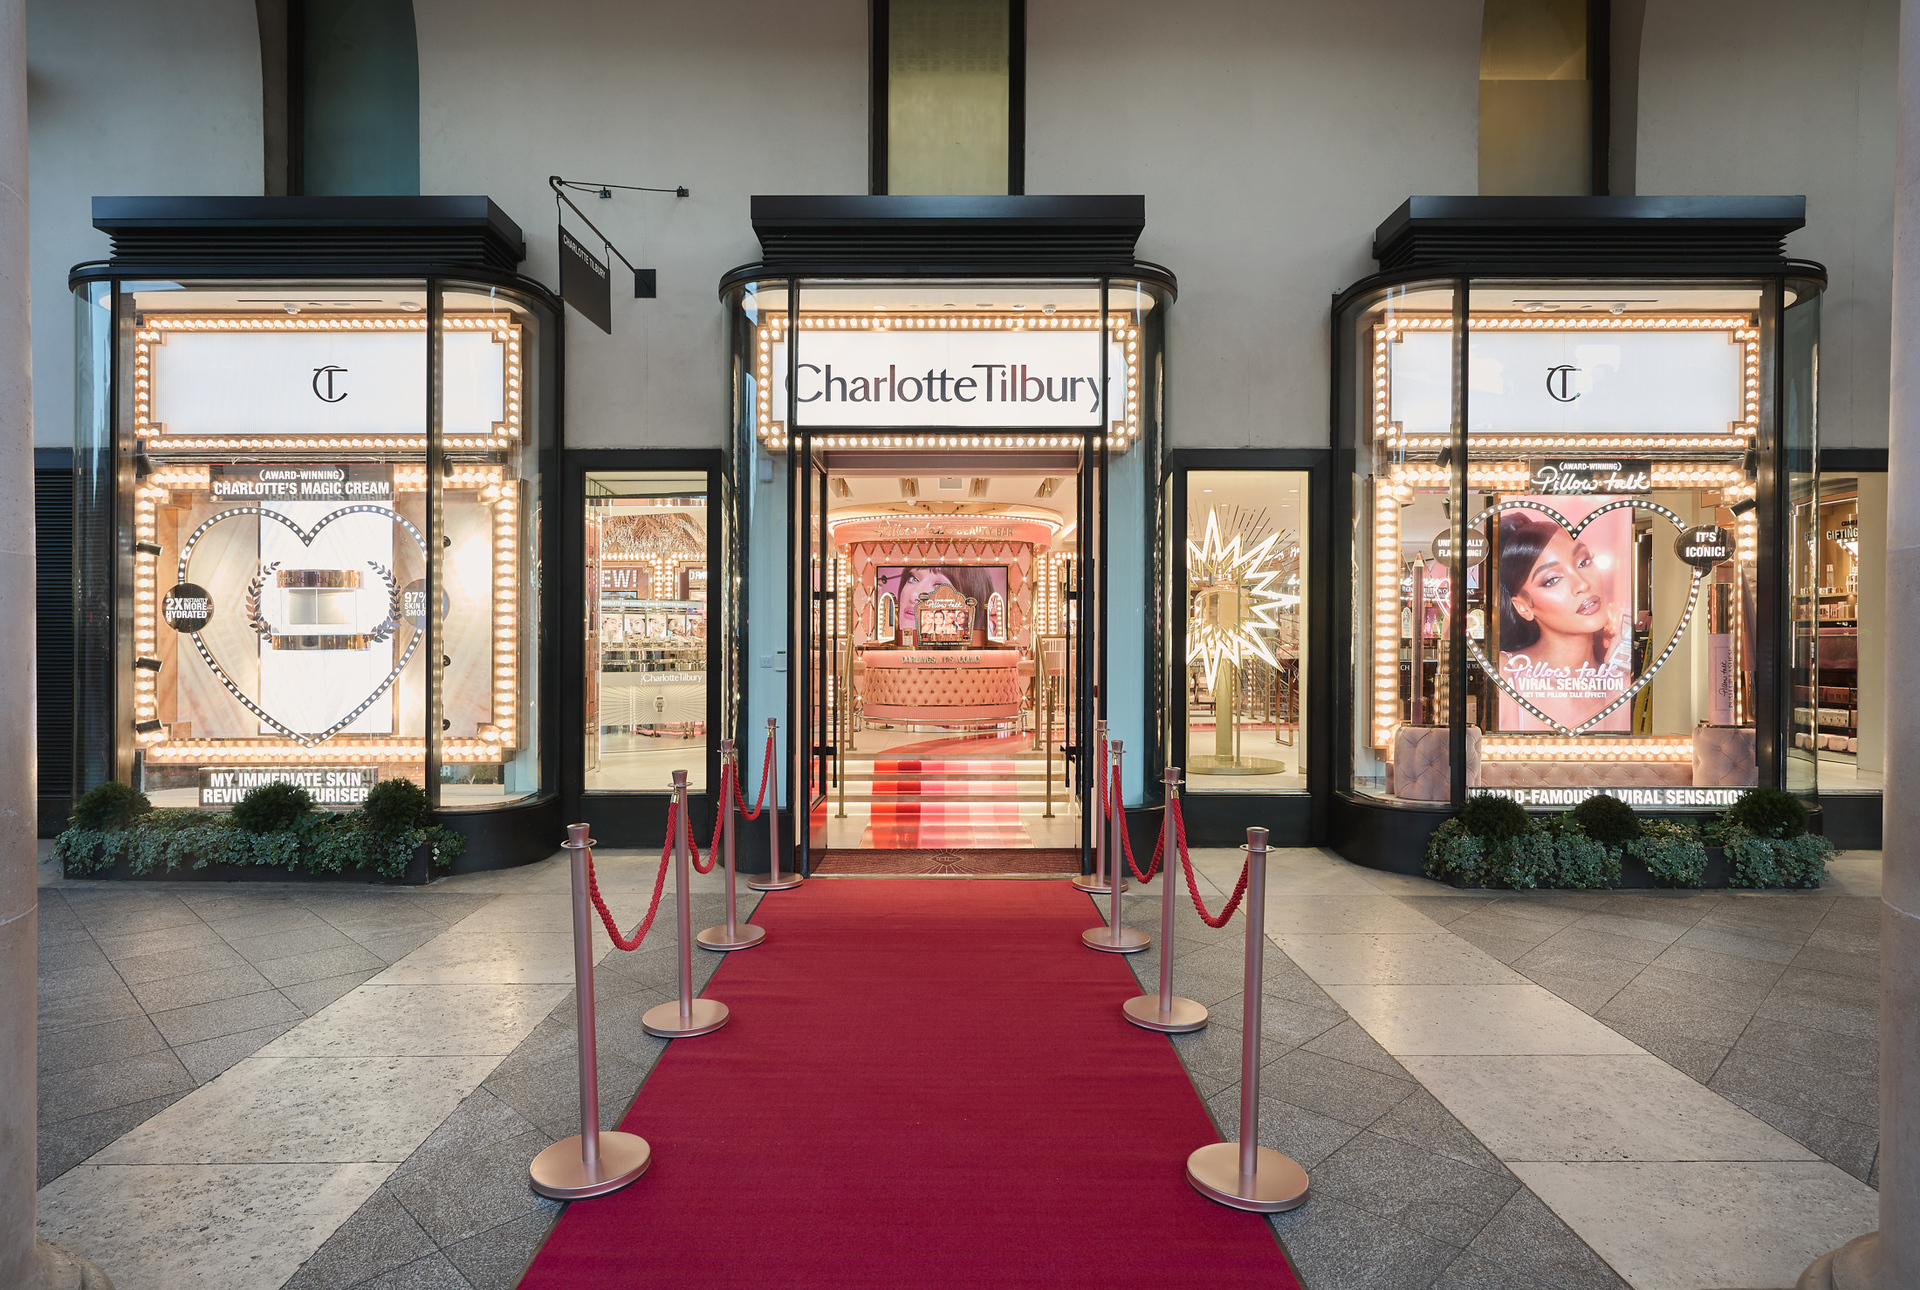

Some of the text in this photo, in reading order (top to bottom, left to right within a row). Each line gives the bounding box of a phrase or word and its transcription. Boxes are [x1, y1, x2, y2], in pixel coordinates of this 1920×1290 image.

[1559, 462, 1622, 471] (AWARD-WINNING)
[259, 469, 345, 481] (AWARD-WINNING)
[214, 482, 390, 495] CHARLOTTE'S MAGIC CREAM
[1696, 531, 1717, 543] IT'S
[1685, 546, 1726, 558] ICONIC!
[165, 597, 183, 611] 2X
[183, 602, 207, 611] MORE
[1518, 677, 1553, 690] VIRAL
[1556, 677, 1623, 690] SENSATION
[211, 772, 235, 787] MY
[326, 772, 361, 787] SKIN
[1617, 789, 1662, 804] VIRAL
